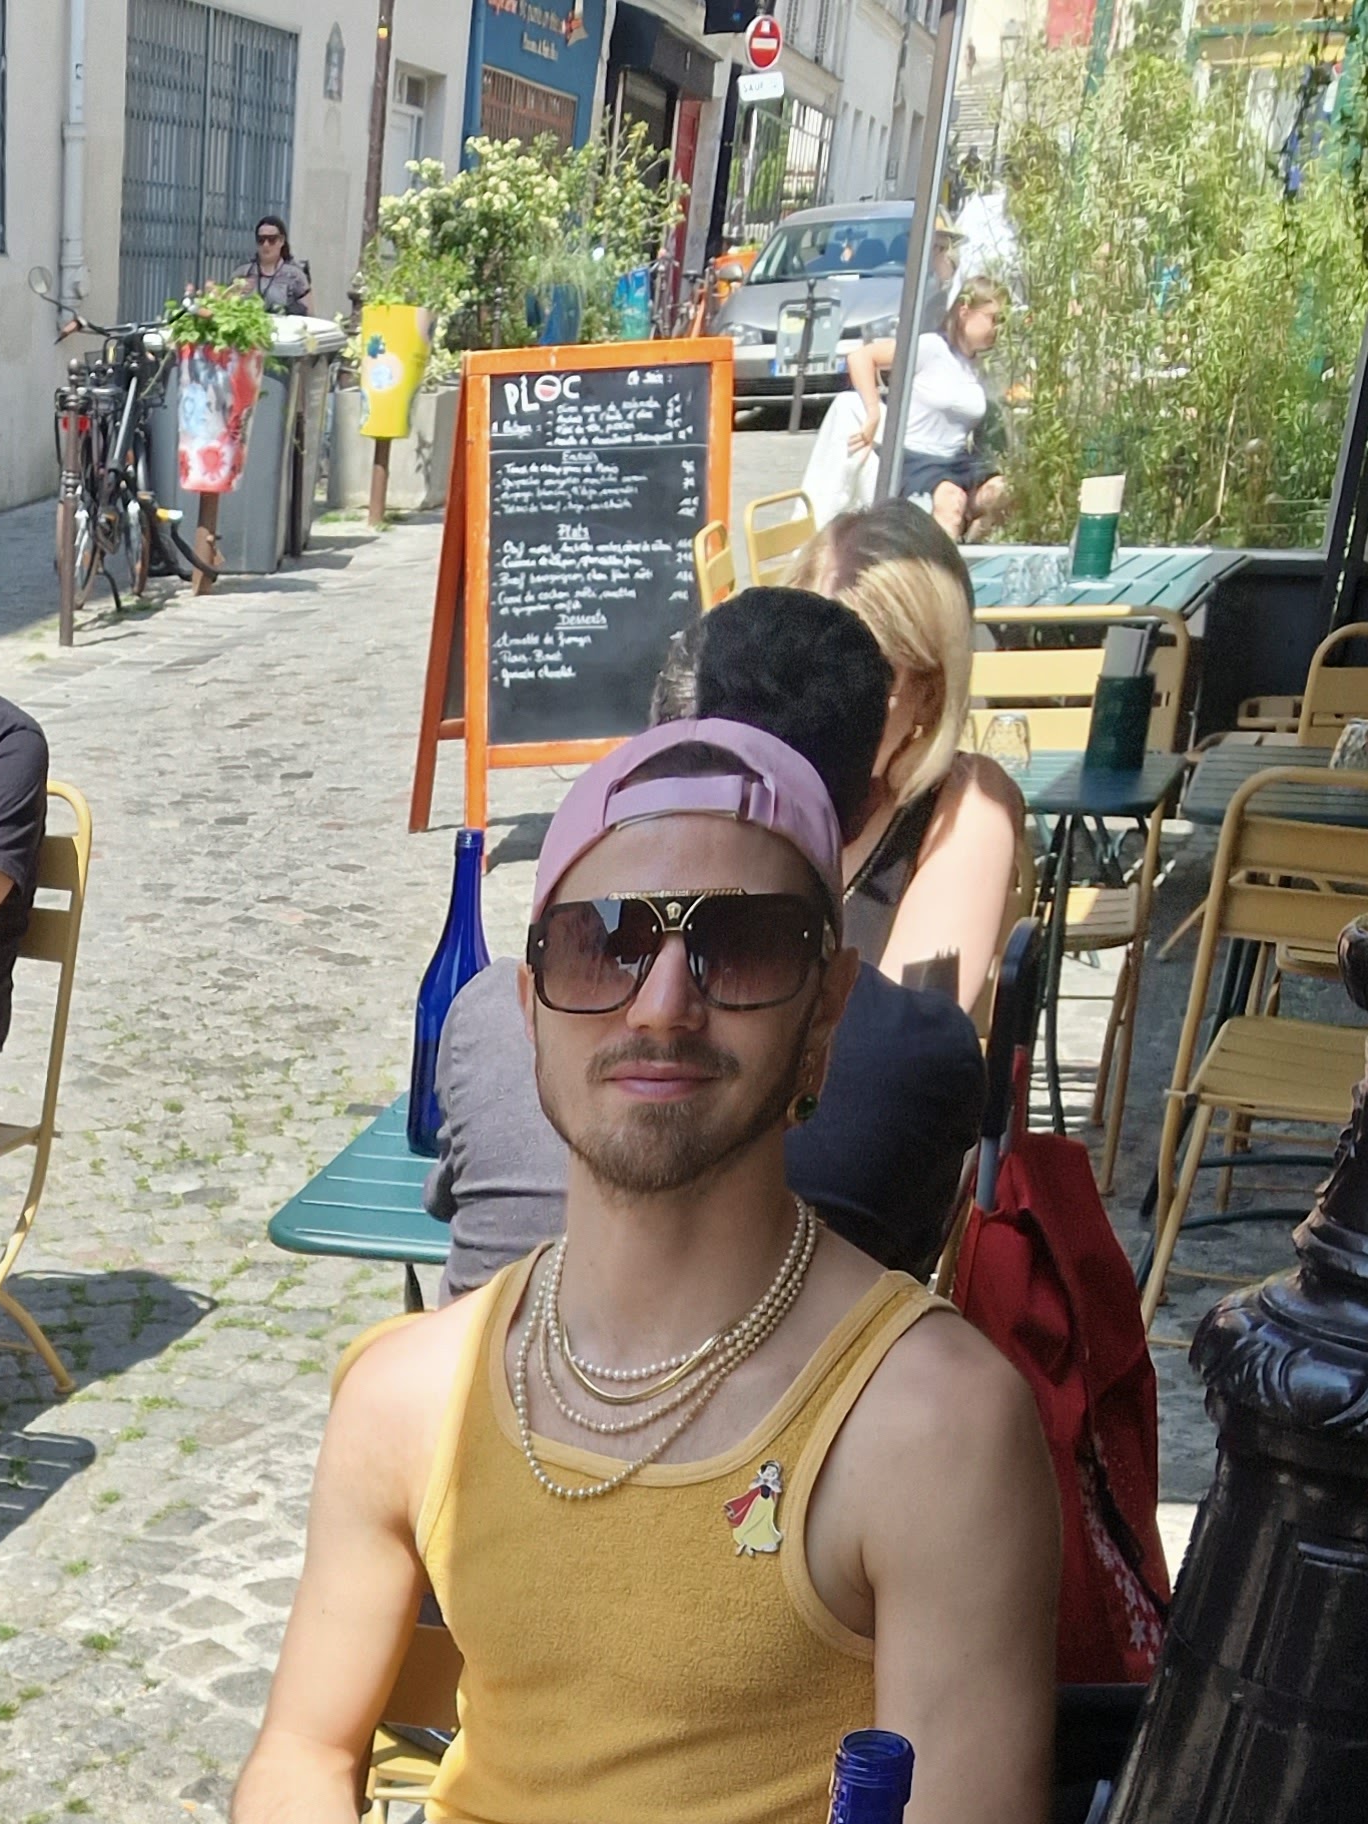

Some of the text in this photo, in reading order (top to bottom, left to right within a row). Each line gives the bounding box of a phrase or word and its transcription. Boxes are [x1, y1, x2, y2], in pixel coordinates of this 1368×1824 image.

[504, 374, 581, 415] PLOC
[557, 522, 590, 538] Plats
[555, 608, 608, 625] Desserts
